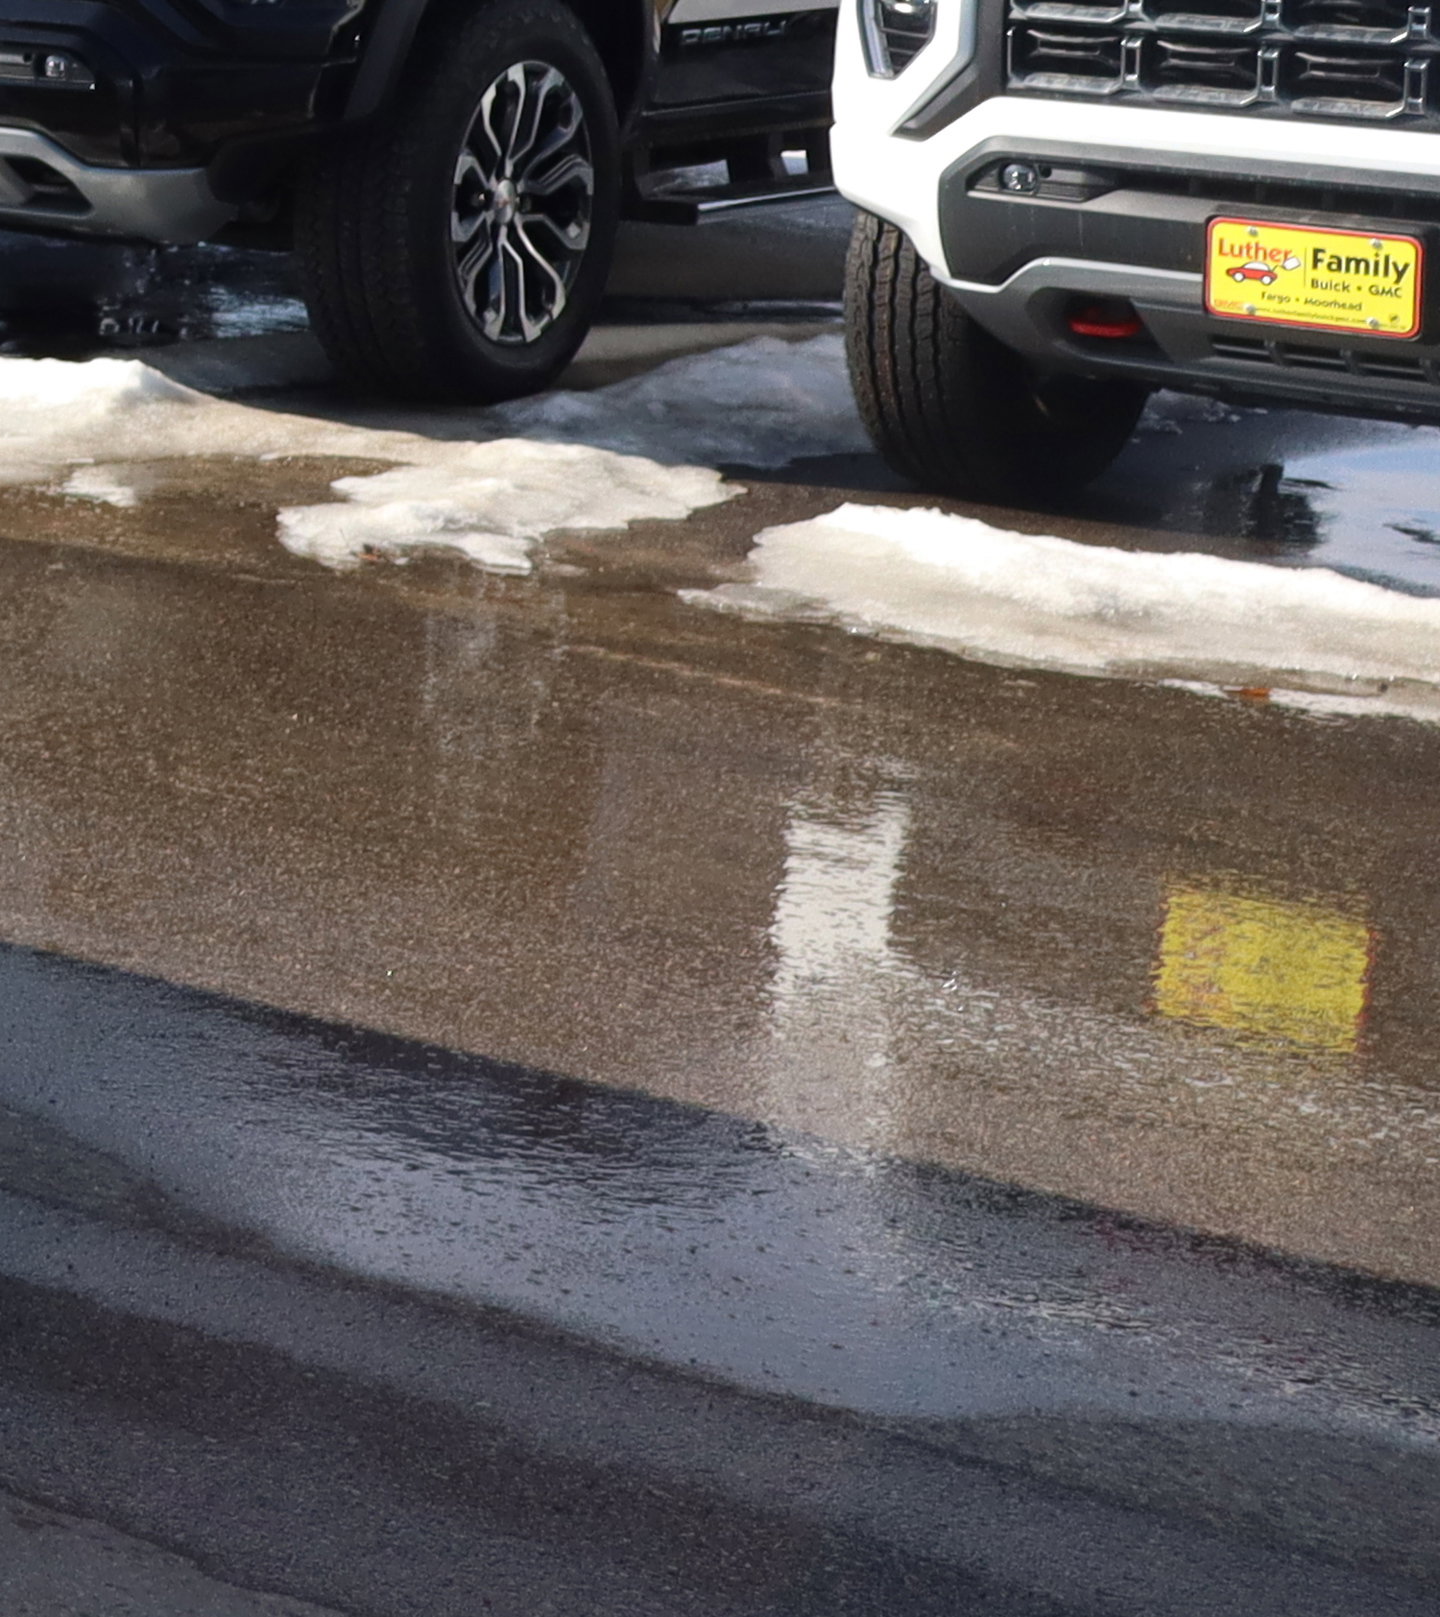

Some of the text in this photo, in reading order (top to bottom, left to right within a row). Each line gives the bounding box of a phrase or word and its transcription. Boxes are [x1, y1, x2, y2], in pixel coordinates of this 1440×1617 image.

[1218, 237, 1411, 285] Luther Family
[1310, 277, 1403, 299] Buick GMC
[1260, 290, 1363, 312] Fargo Moorhead
